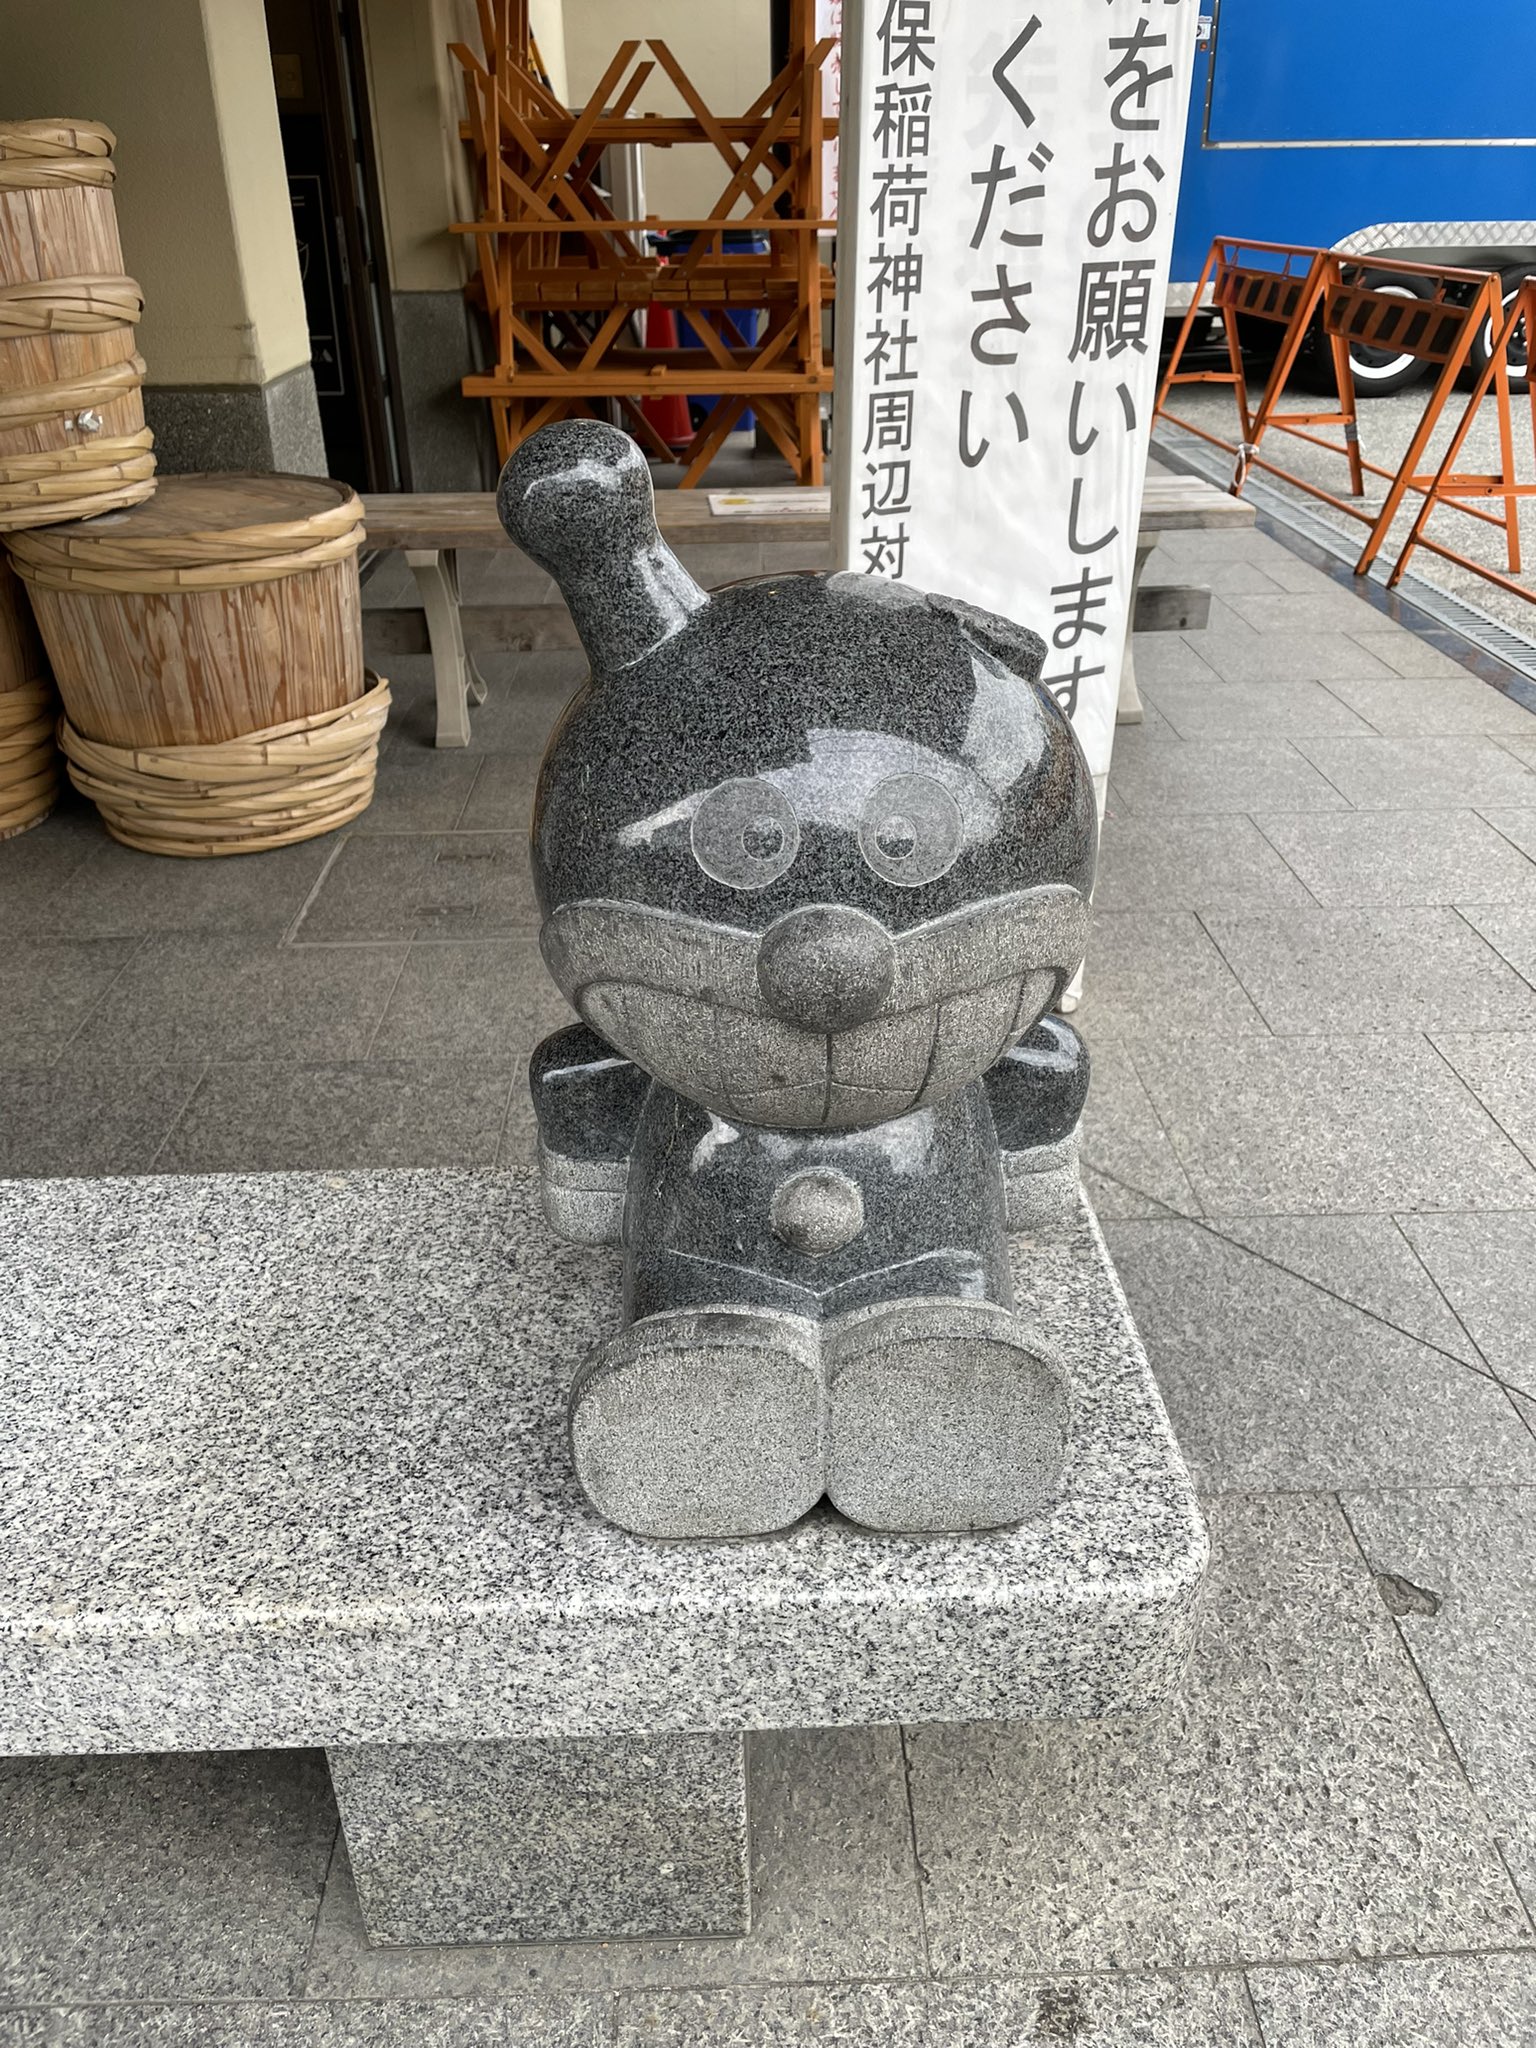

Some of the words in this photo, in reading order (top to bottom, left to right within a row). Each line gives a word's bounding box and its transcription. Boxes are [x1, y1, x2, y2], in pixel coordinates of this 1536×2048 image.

[861, 0, 936, 580] 保稲荷神社周辺対
[958, 13, 1055, 469] ください
[1043, 0, 1181, 721] をお願いします
